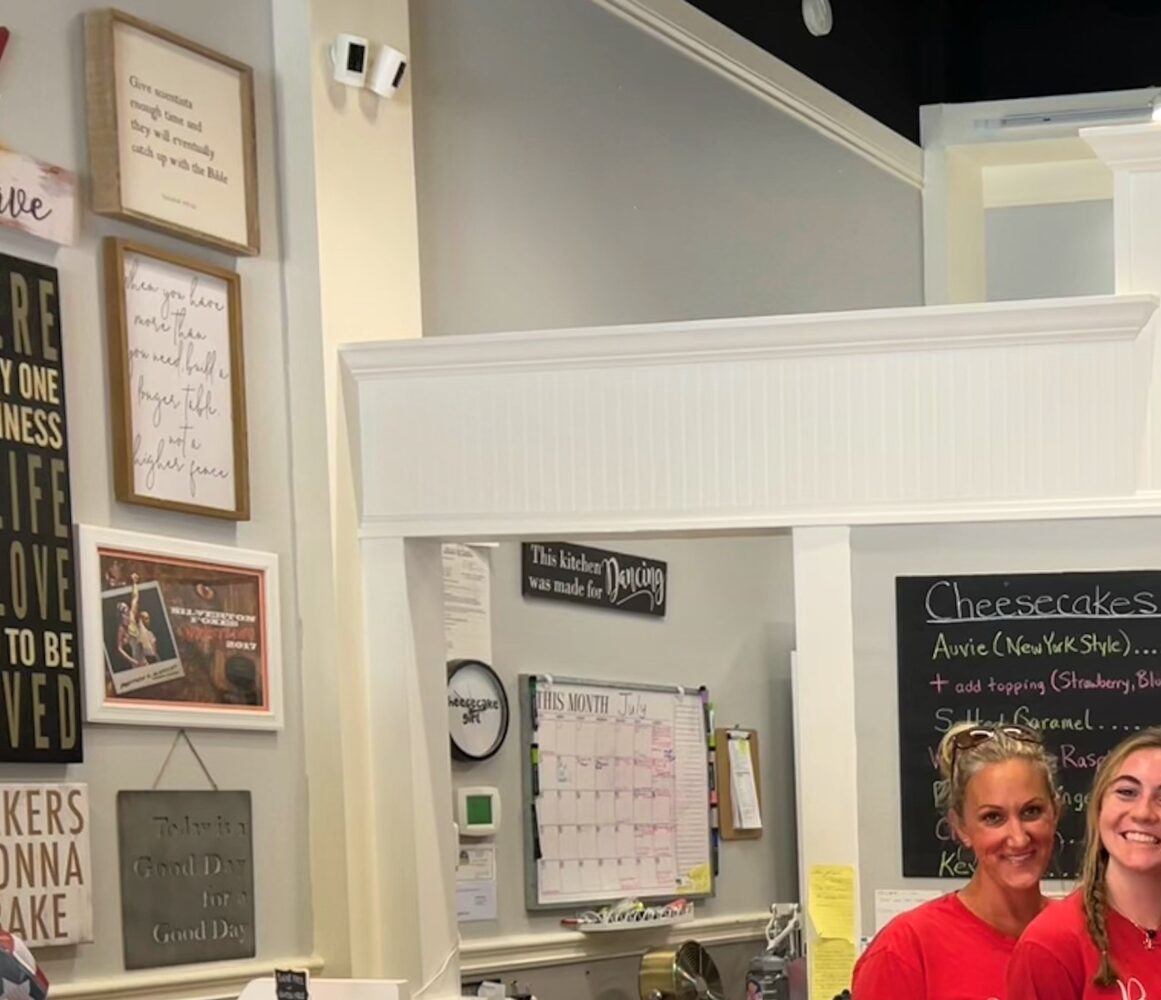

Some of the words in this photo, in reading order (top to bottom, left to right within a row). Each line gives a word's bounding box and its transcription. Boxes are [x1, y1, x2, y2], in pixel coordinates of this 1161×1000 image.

[129, 75, 152, 93] Give
[130, 119, 151, 138] they
[153, 128, 170, 142] will
[164, 110, 184, 126] time
[186, 120, 203, 133] and
[131, 144, 154, 158] catch
[156, 153, 169, 168] up
[169, 157, 190, 171] with
[191, 162, 205, 176] the
[207, 166, 229, 184] Bible
[162, 287, 185, 320] you
[189, 276, 224, 312] have
[134, 314, 171, 333] more
[171, 307, 207, 345] than
[18, 363, 60, 405] ONE
[219, 367, 229, 381] a
[137, 375, 181, 428] longer
[168, 419, 194, 459] not
[191, 441, 201, 451] a
[132, 434, 184, 490] higher
[190, 460, 229, 498] fence
[0, 450, 68, 538] IFE
[0, 540, 72, 623] OVE
[528, 575, 551, 591] was
[554, 576, 585, 597] made
[587, 579, 602, 600] for
[530, 543, 557, 567] This
[560, 549, 602, 575] kitchen
[601, 557, 665, 606] Dancing
[925, 580, 1159, 620] Cheesecakes
[4, 627, 36, 667] TO
[43, 630, 74, 669] BE
[225, 640, 257, 651] 2017
[931, 632, 989, 660] Auvie
[537, 690, 565, 712] THIS
[568, 693, 609, 714] MONTH
[955, 679, 982, 694] add
[987, 673, 1047, 696] topping
[2, 670, 77, 750] VED
[448, 695, 499, 713] heesecake
[618, 692, 647, 720] July
[0, 788, 85, 837] KERS
[217, 815, 232, 836] is
[133, 853, 195, 878] Good
[6, 893, 68, 941] AKE
[153, 919, 207, 944] Good
[213, 918, 249, 944] Day
